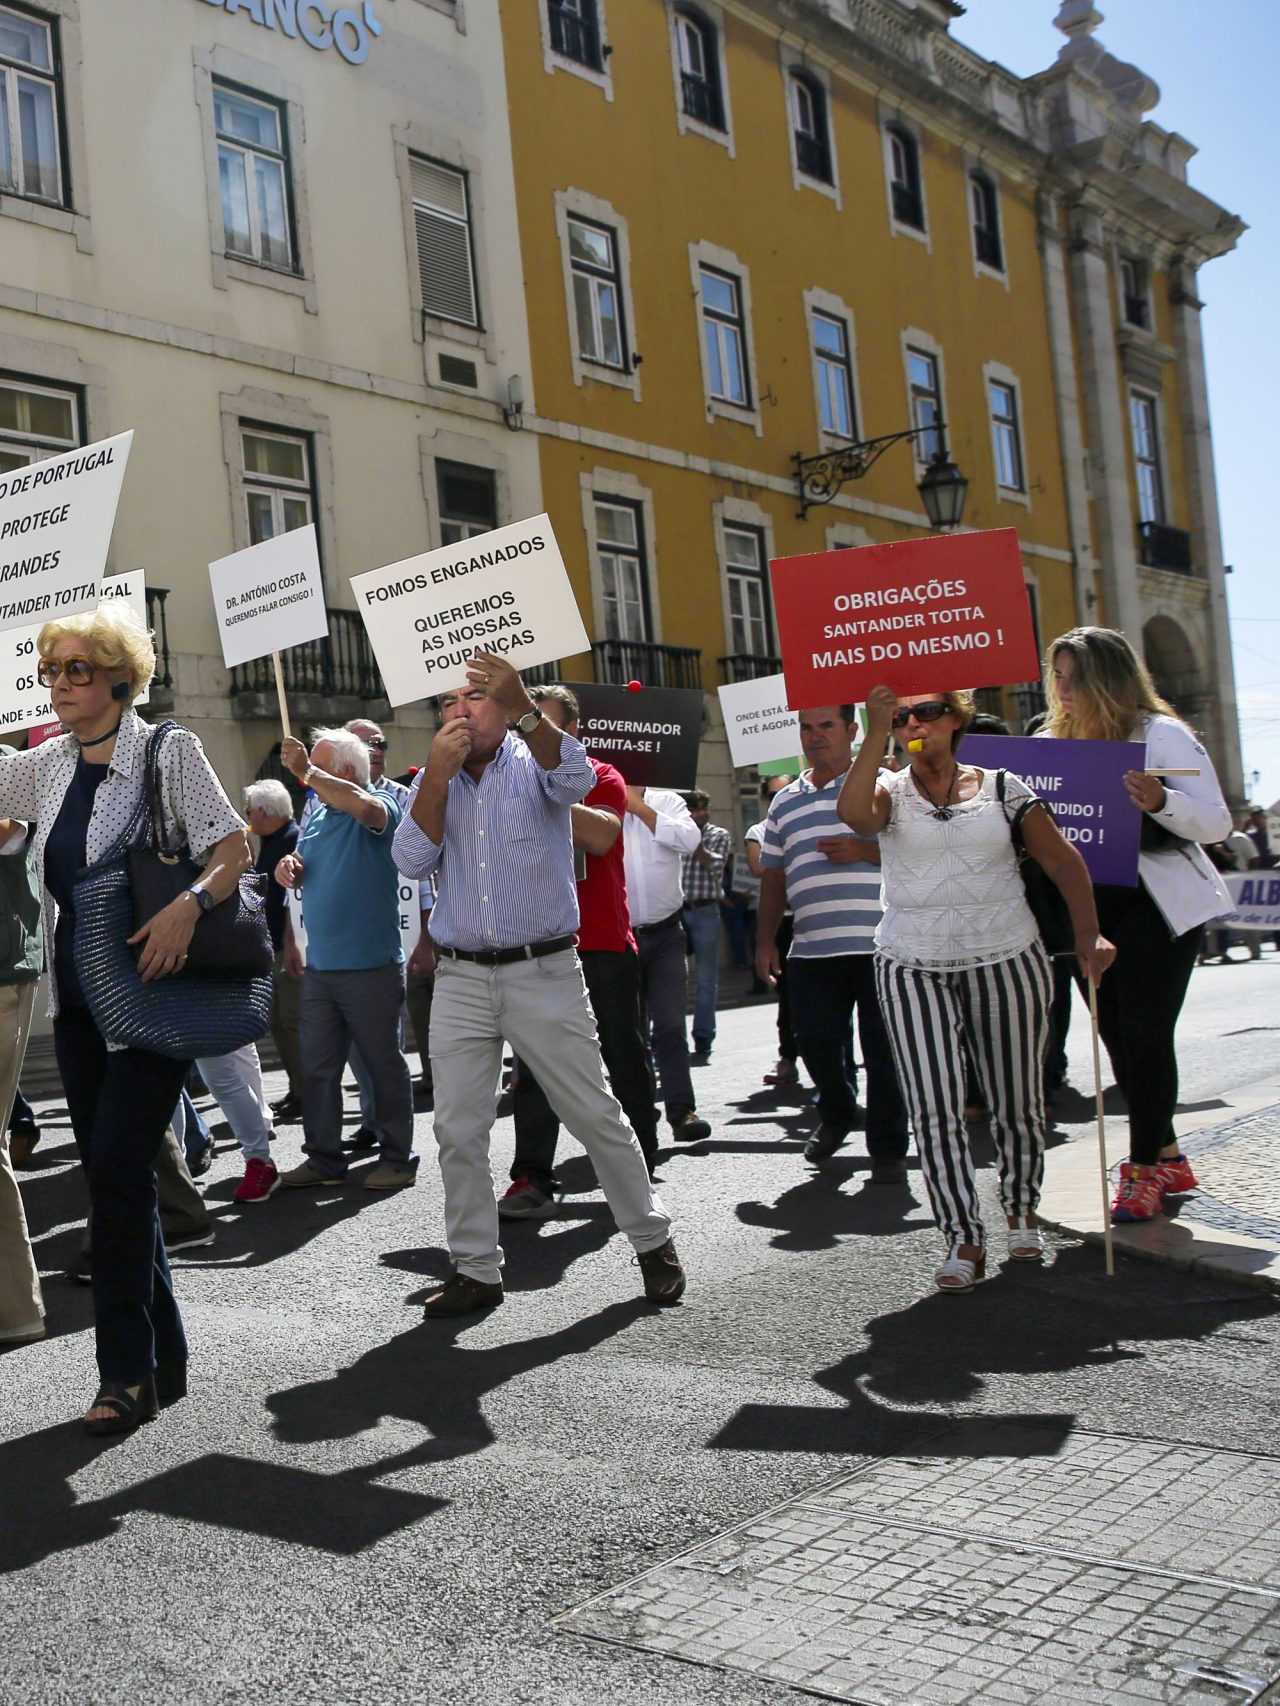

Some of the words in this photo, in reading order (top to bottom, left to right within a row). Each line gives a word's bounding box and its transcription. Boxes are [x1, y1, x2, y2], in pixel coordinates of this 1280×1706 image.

[10, 475, 31, 497] DE
[32, 447, 114, 489] PORTUGAL
[1, 504, 71, 540] PROTEGE
[365, 574, 427, 605] FOMOS
[430, 536, 545, 584] ENGANADOS
[54, 582, 96, 606] TOTTA
[226, 597, 239, 609] DR.
[240, 582, 277, 605] ANTÓNIO
[278, 571, 307, 590] COSTA
[833, 579, 967, 611] OBRIGAÇÕES
[225, 608, 258, 627] QUEREMOS
[258, 600, 278, 615] FALAR
[279, 590, 309, 607] CONSIGO
[414, 591, 515, 633] QUEREMOS
[823, 613, 926, 639] SANTANDER
[928, 606, 985, 626] TOTTA
[16, 638, 34, 657] SÓ
[421, 635, 445, 654] AS
[447, 611, 522, 645] NOSSAS
[811, 647, 866, 669] MAIS
[870, 642, 902, 662] DO
[907, 631, 991, 657] MESMO
[16, 675, 34, 691] OS
[588, 718, 681, 736] GOVERNADOR
[735, 710, 760, 722] ONDE
[762, 704, 783, 717] ESTÁ
[742, 724, 759, 736] ATÉ
[762, 718, 797, 732] AGORA
[582, 736, 653, 753] DEMITA-SE
